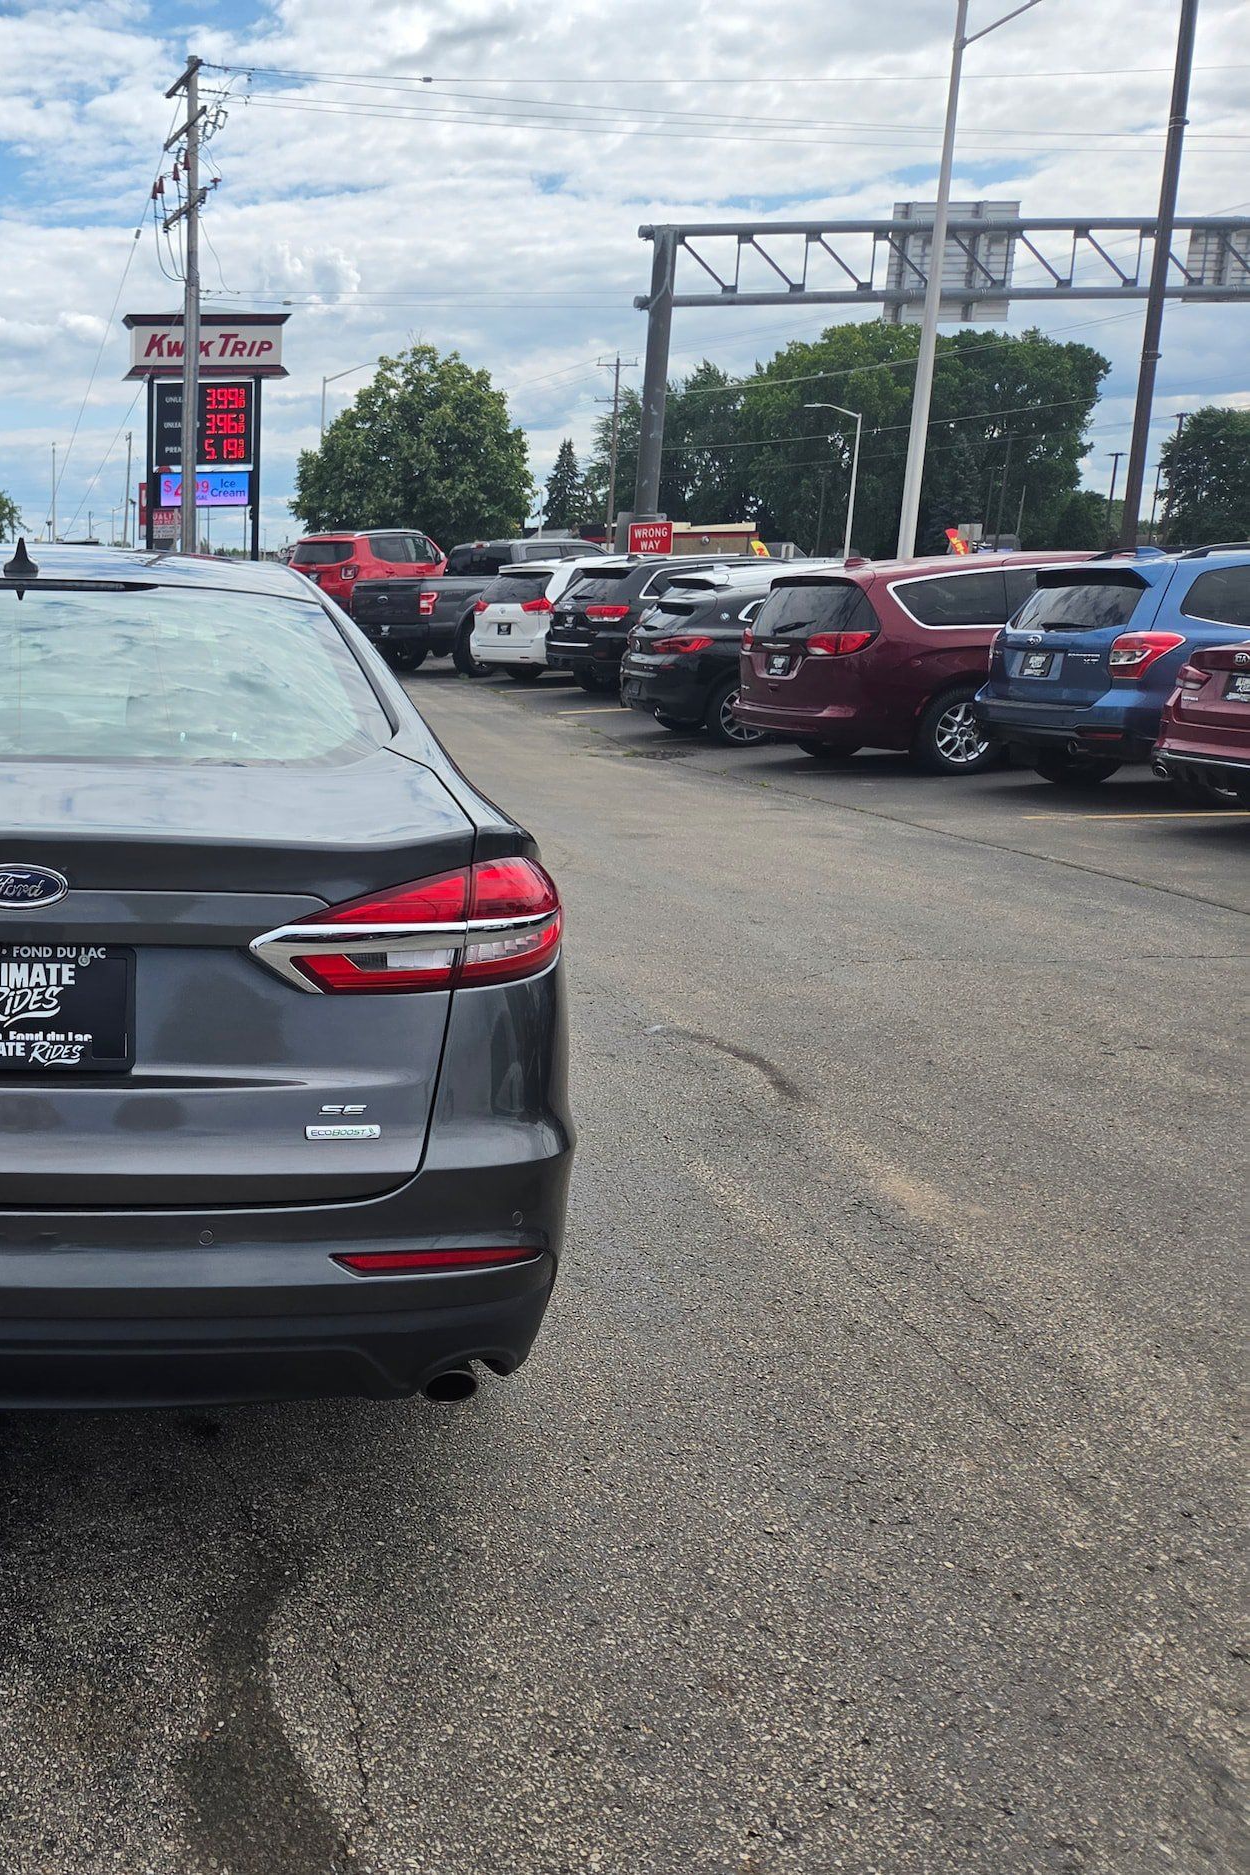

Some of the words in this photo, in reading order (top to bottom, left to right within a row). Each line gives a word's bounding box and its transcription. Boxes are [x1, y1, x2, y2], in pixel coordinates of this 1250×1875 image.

[144, 333, 215, 357] KWK
[218, 333, 273, 357] TRIP
[220, 478, 236, 488] Ice
[210, 488, 246, 497] Cream
[634, 527, 668, 539] WRONG
[640, 540, 661, 551] WAY
[13, 946, 52, 958] FOND
[57, 946, 76, 958] DU
[318, 1104, 368, 1116] SE
